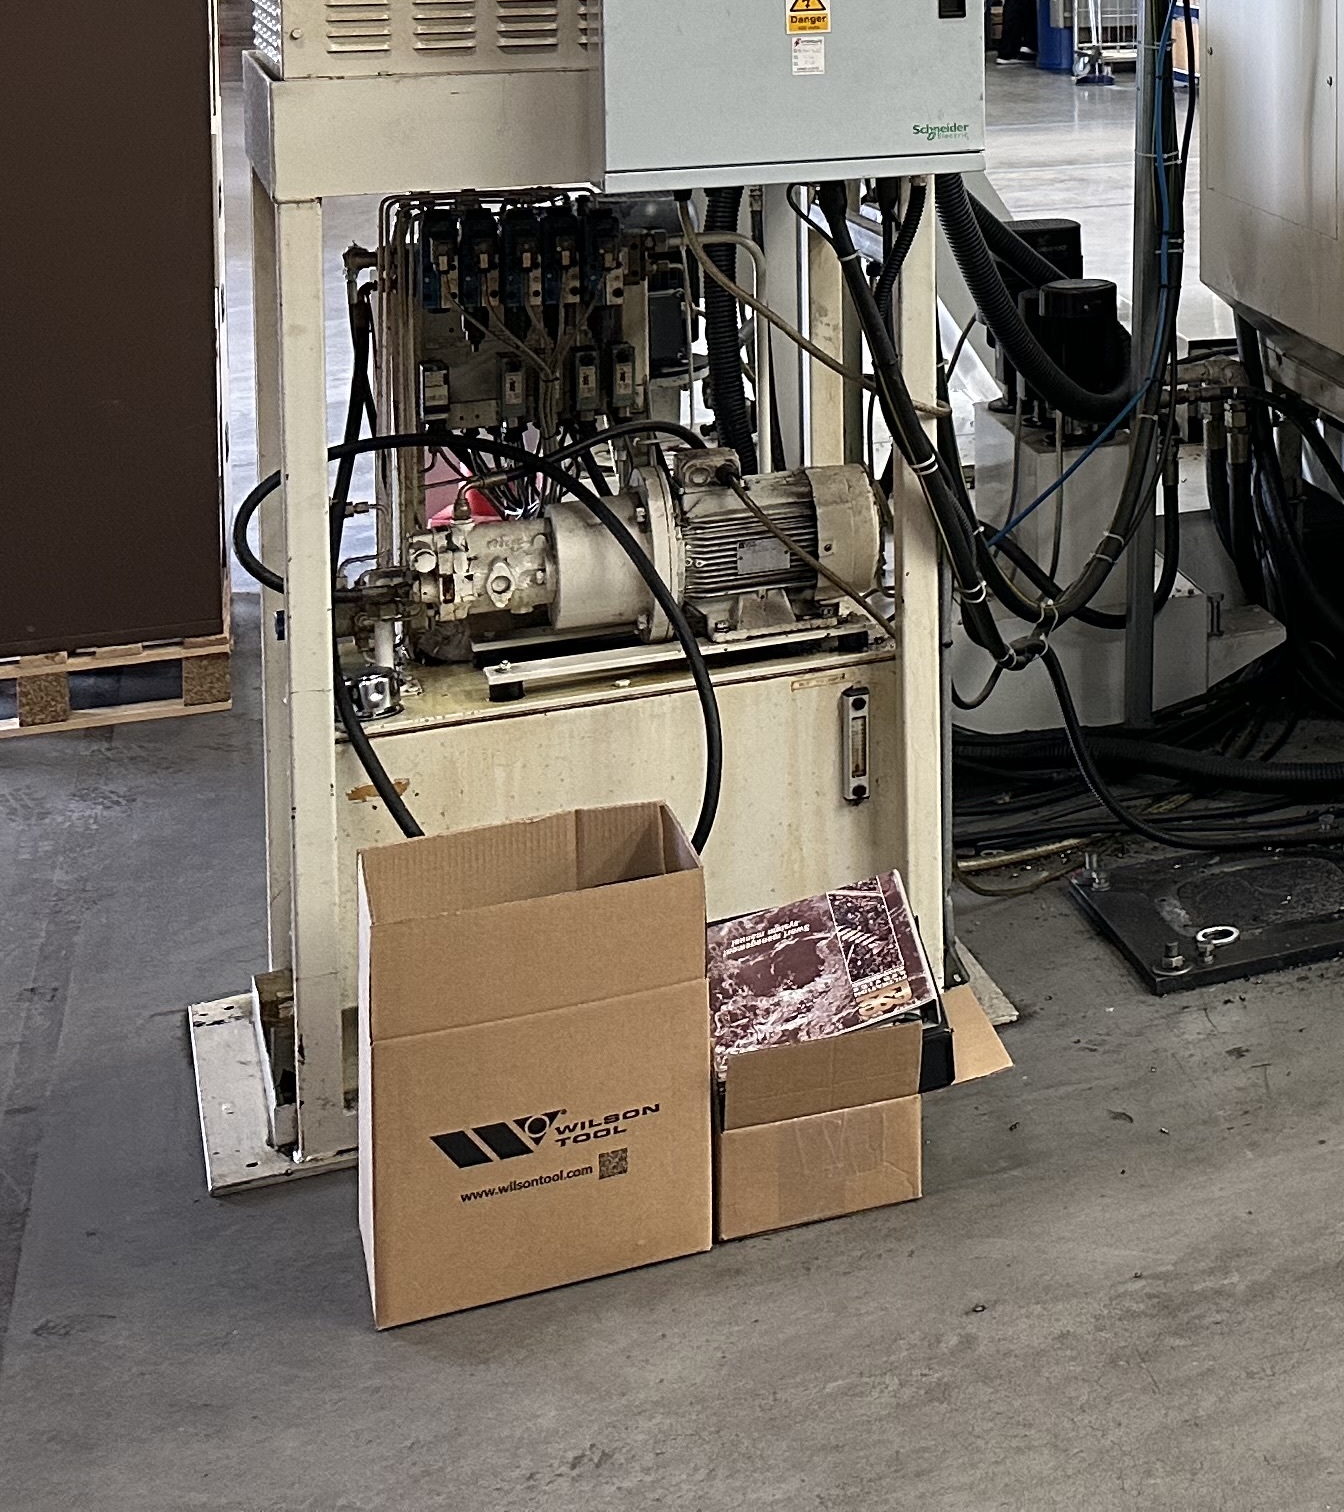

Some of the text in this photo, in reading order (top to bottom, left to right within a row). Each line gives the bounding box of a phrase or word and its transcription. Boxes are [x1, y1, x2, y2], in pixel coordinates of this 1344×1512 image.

[790, 15, 827, 25] Danger
[912, 122, 969, 141] Schneider
[554, 1103, 661, 1136] WILSON
[554, 1125, 628, 1148] TOOL
[460, 1164, 593, 1203] www.wilsontool.com
